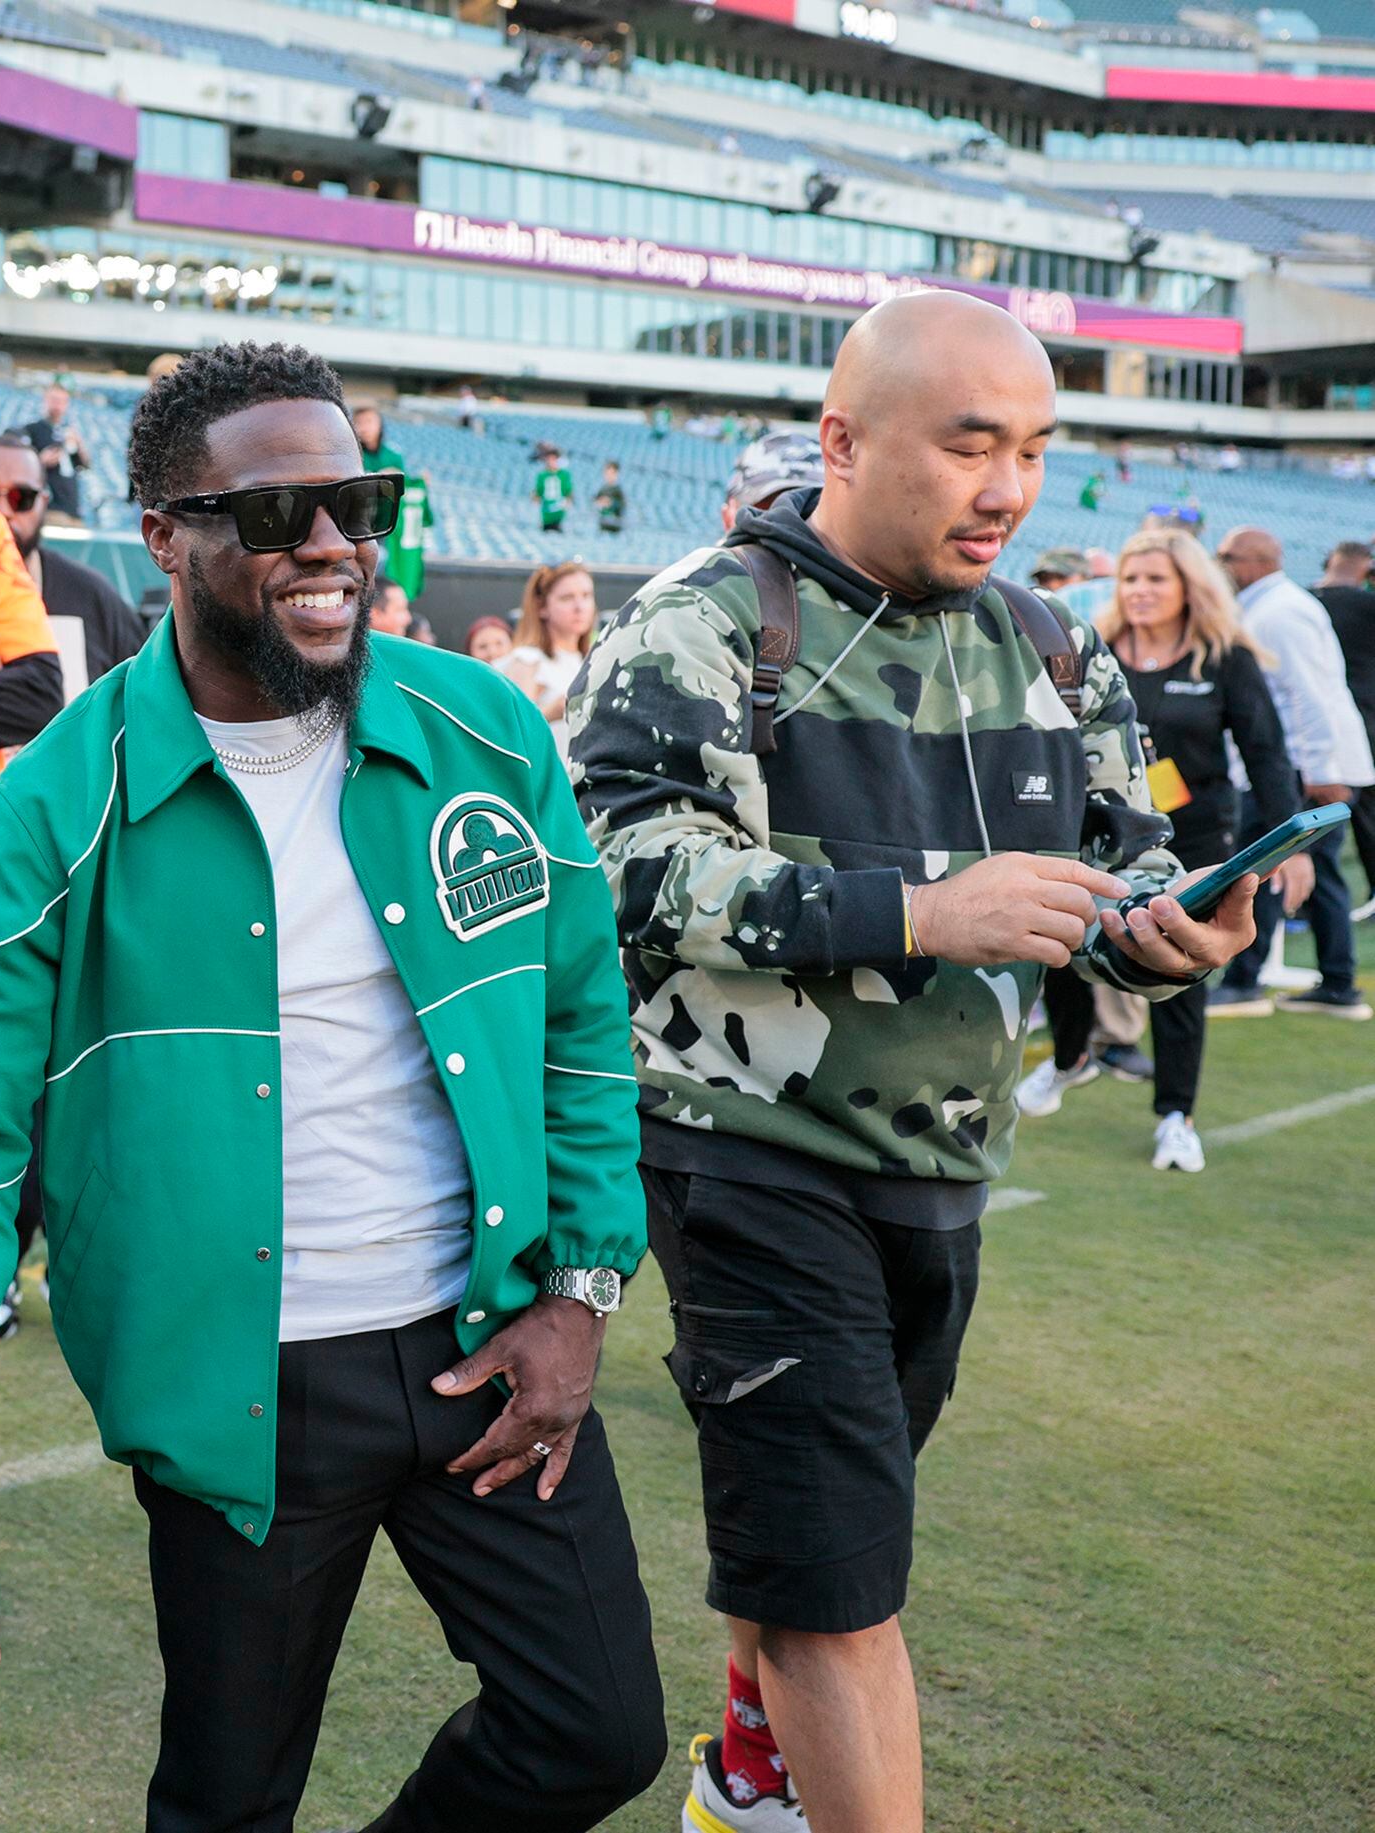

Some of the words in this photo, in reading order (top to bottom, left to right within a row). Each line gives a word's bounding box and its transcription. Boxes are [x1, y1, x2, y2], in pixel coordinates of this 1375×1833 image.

[443, 214, 533, 262] Lincoln
[534, 227, 637, 275] Financial
[638, 241, 708, 288] Group
